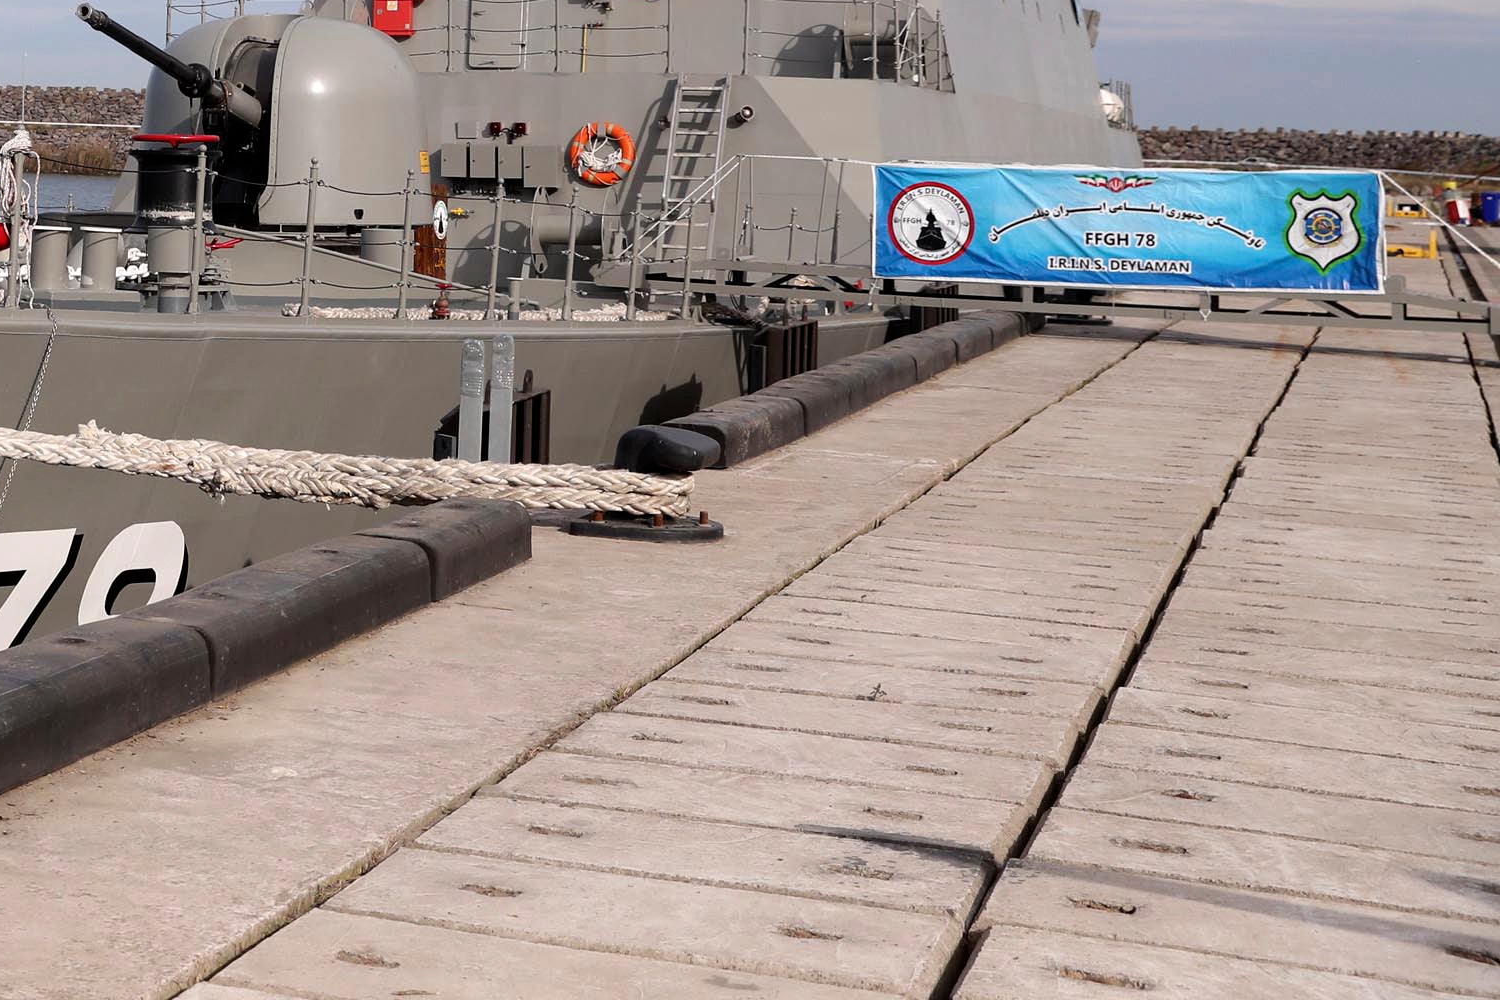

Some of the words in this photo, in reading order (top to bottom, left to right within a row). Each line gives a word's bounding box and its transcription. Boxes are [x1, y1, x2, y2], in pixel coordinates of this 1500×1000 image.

[925, 187, 965, 215] DEYLAMAN
[1052, 203, 1106, 217] ایران
[1166, 208, 1205, 224] جمهوری
[1084, 232, 1129, 246] FFGH
[1135, 233, 1156, 247] 78
[1207, 218, 1264, 249] ناوشکن
[1110, 259, 1190, 273] DEYLAMAN
